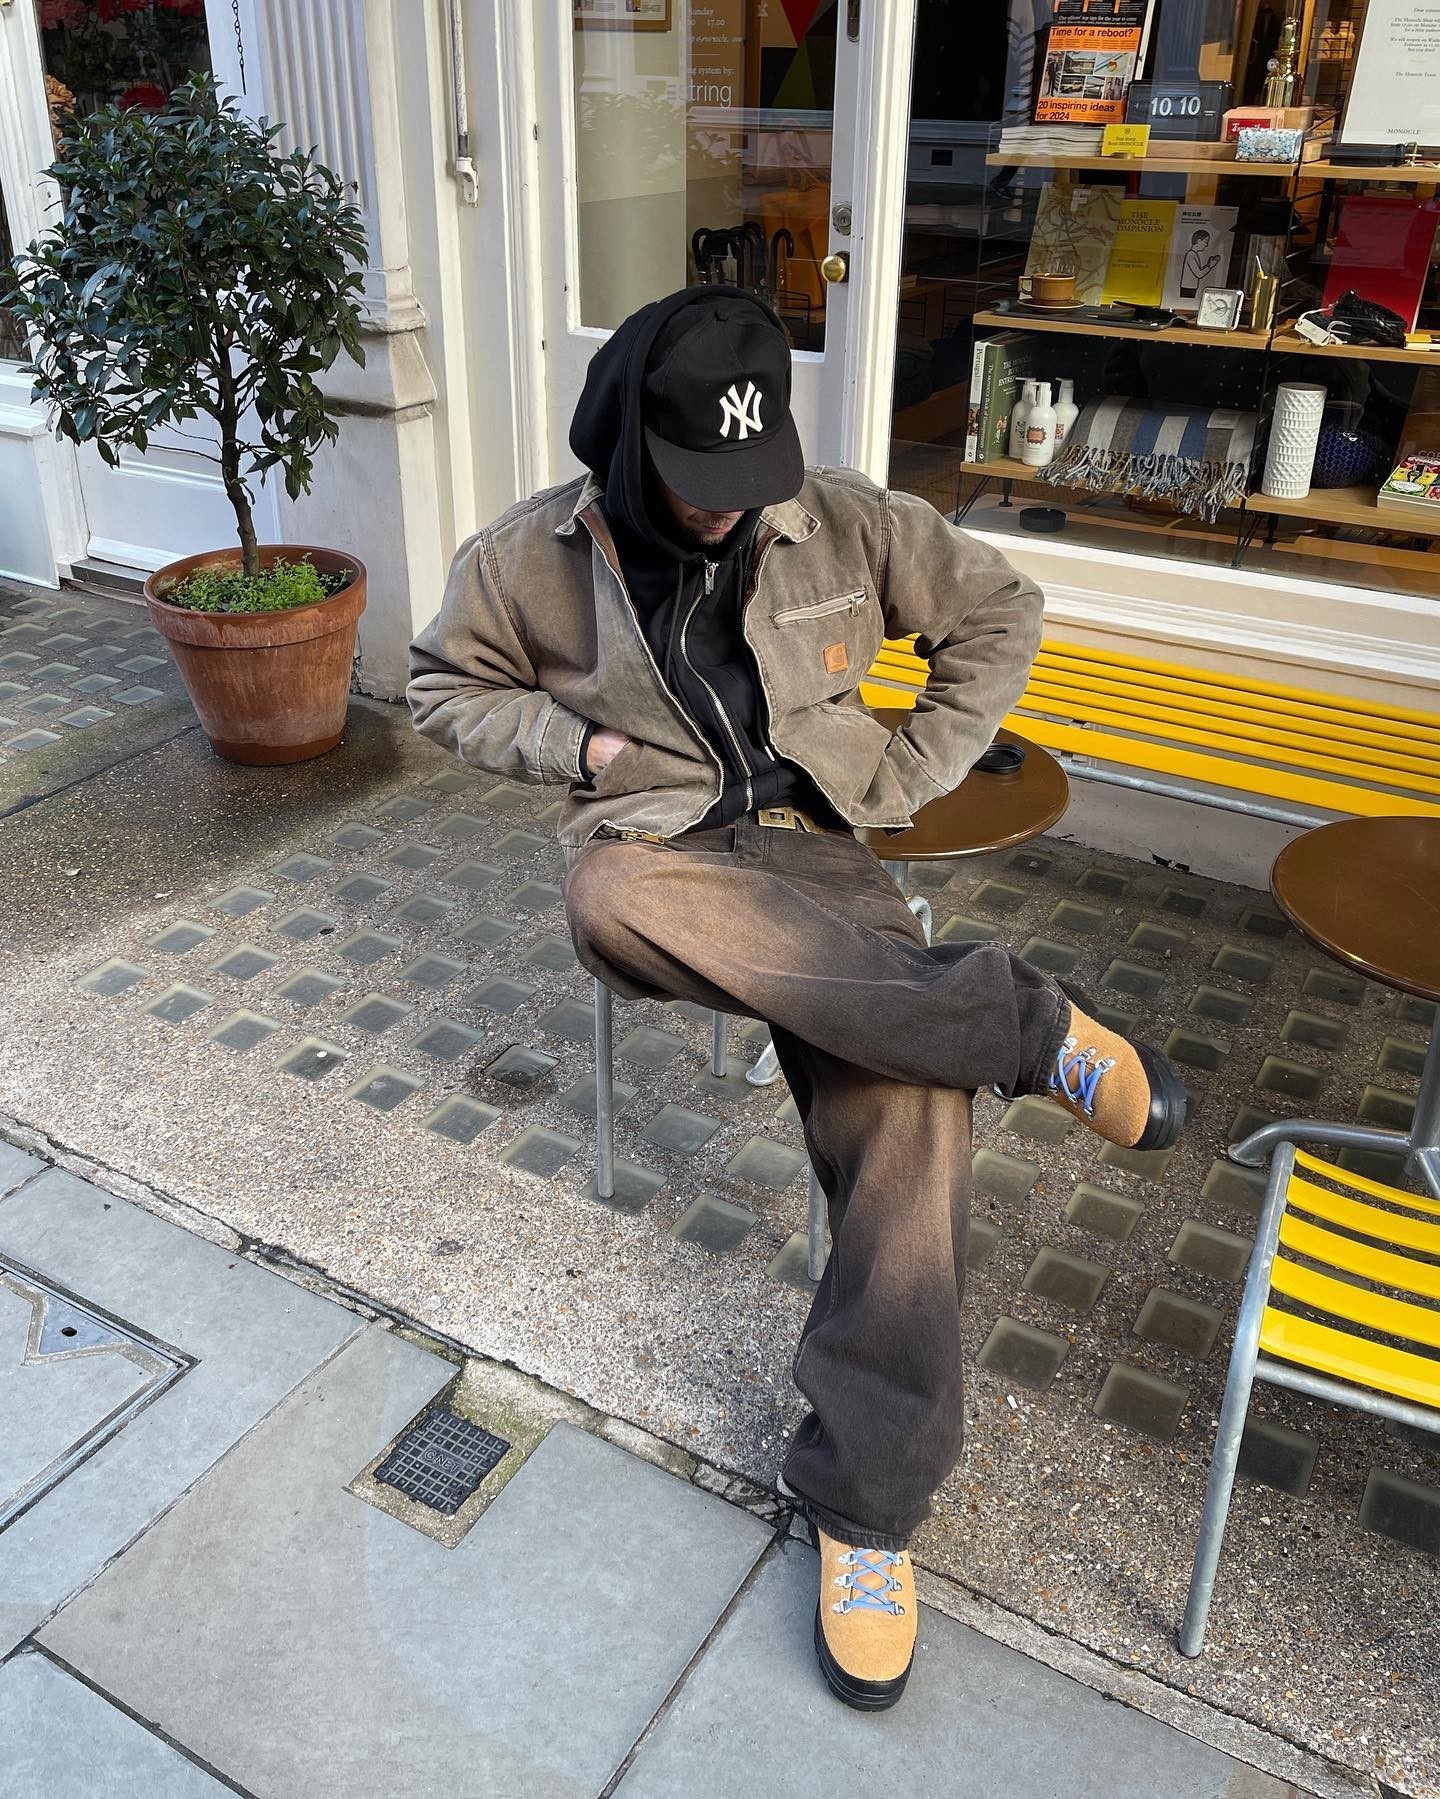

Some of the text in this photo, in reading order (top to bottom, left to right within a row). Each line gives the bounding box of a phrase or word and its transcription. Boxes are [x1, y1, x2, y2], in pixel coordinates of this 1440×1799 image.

[1051, 28, 1072, 36] Time
[1074, 27, 1087, 36] for
[1097, 28, 1134, 37] reboot?
[687, 79, 732, 109] tring
[1038, 101, 1115, 112] 20 inspiring ideas
[1036, 112, 1048, 120] for
[1048, 112, 1070, 120] 2024
[1130, 211, 1150, 219] THE
[1116, 225, 1163, 233] OMPANION
[974, 348, 983, 378] Portugal
[719, 380, 764, 440] NY
